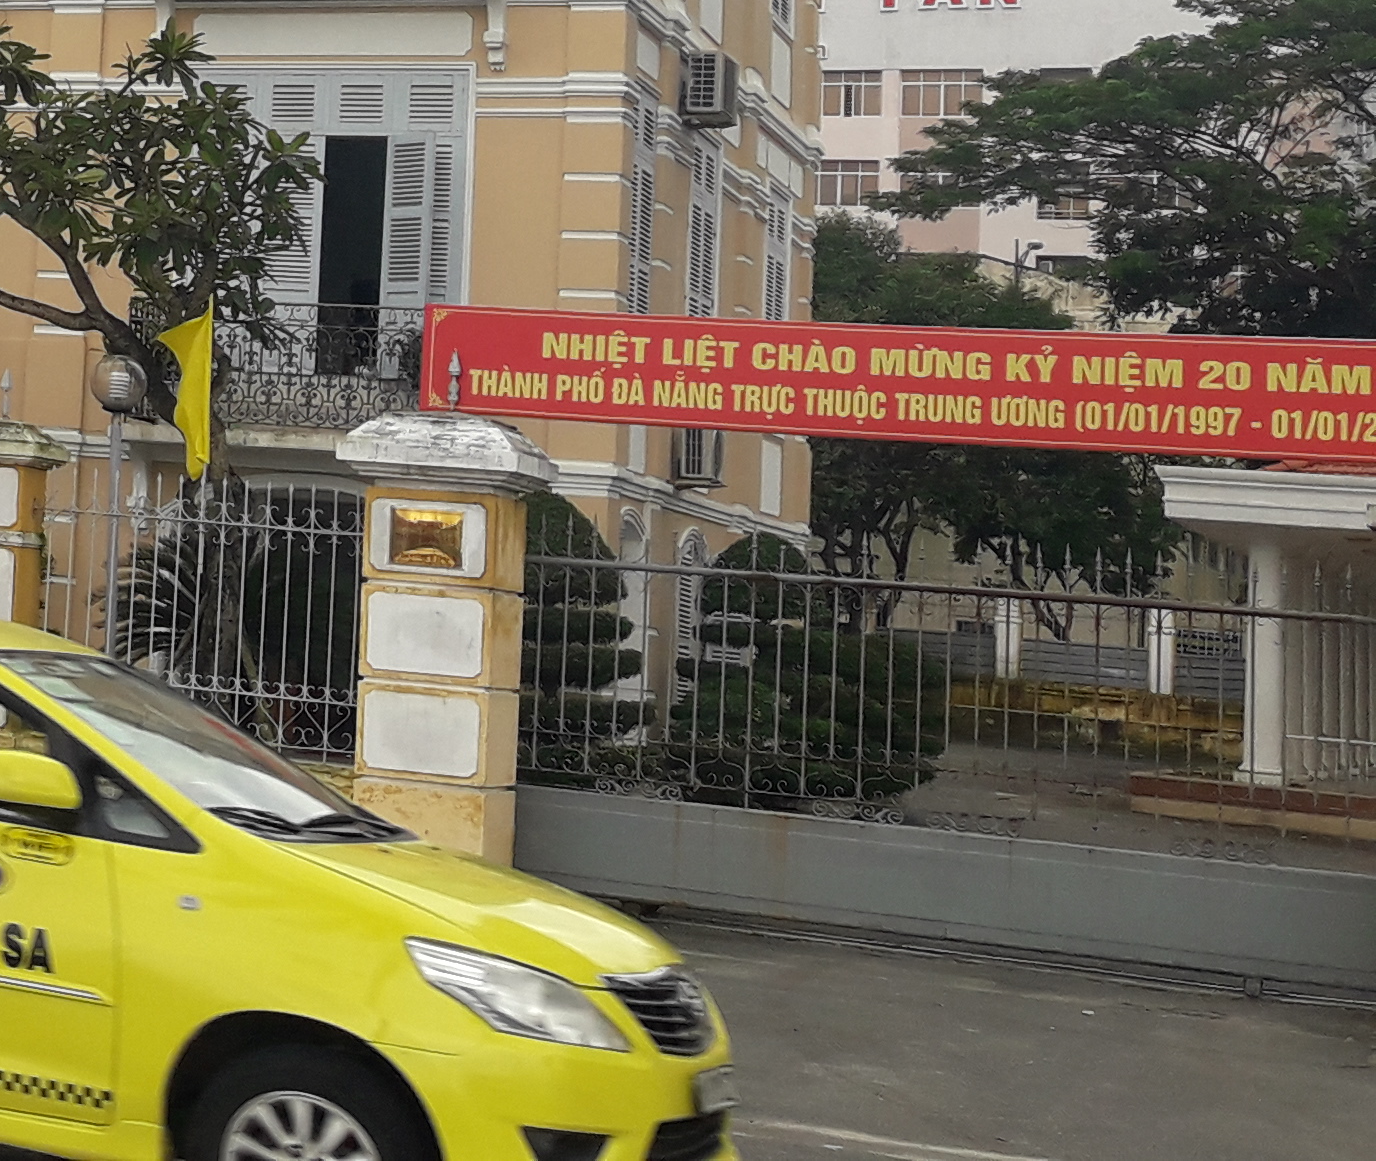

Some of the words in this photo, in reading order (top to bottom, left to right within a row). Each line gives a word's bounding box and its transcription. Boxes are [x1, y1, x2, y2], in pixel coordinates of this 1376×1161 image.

[541, 329, 650, 369] NHIỆT
[662, 333, 740, 373] LIỆT
[751, 339, 857, 375] CHÀO
[869, 343, 991, 381] MỪNG
[1005, 345, 1058, 383] KỶ
[1071, 352, 1184, 393] NIỆM
[1198, 360, 1251, 391] 20
[1266, 357, 1372, 395] NĂM
[469, 365, 548, 400] THÀNH
[555, 366, 606, 404] PHỐ
[611, 372, 646, 406] ĐÀ
[652, 370, 723, 410] NẴNG
[731, 384, 795, 420] TRỰC
[803, 384, 887, 425] THUỘC
[894, 392, 982, 425] TRUNG
[990, 395, 1065, 429] ƯƠNG
[1074, 400, 1242, 436] (01/01/1997
[1, 921, 55, 974] SA
